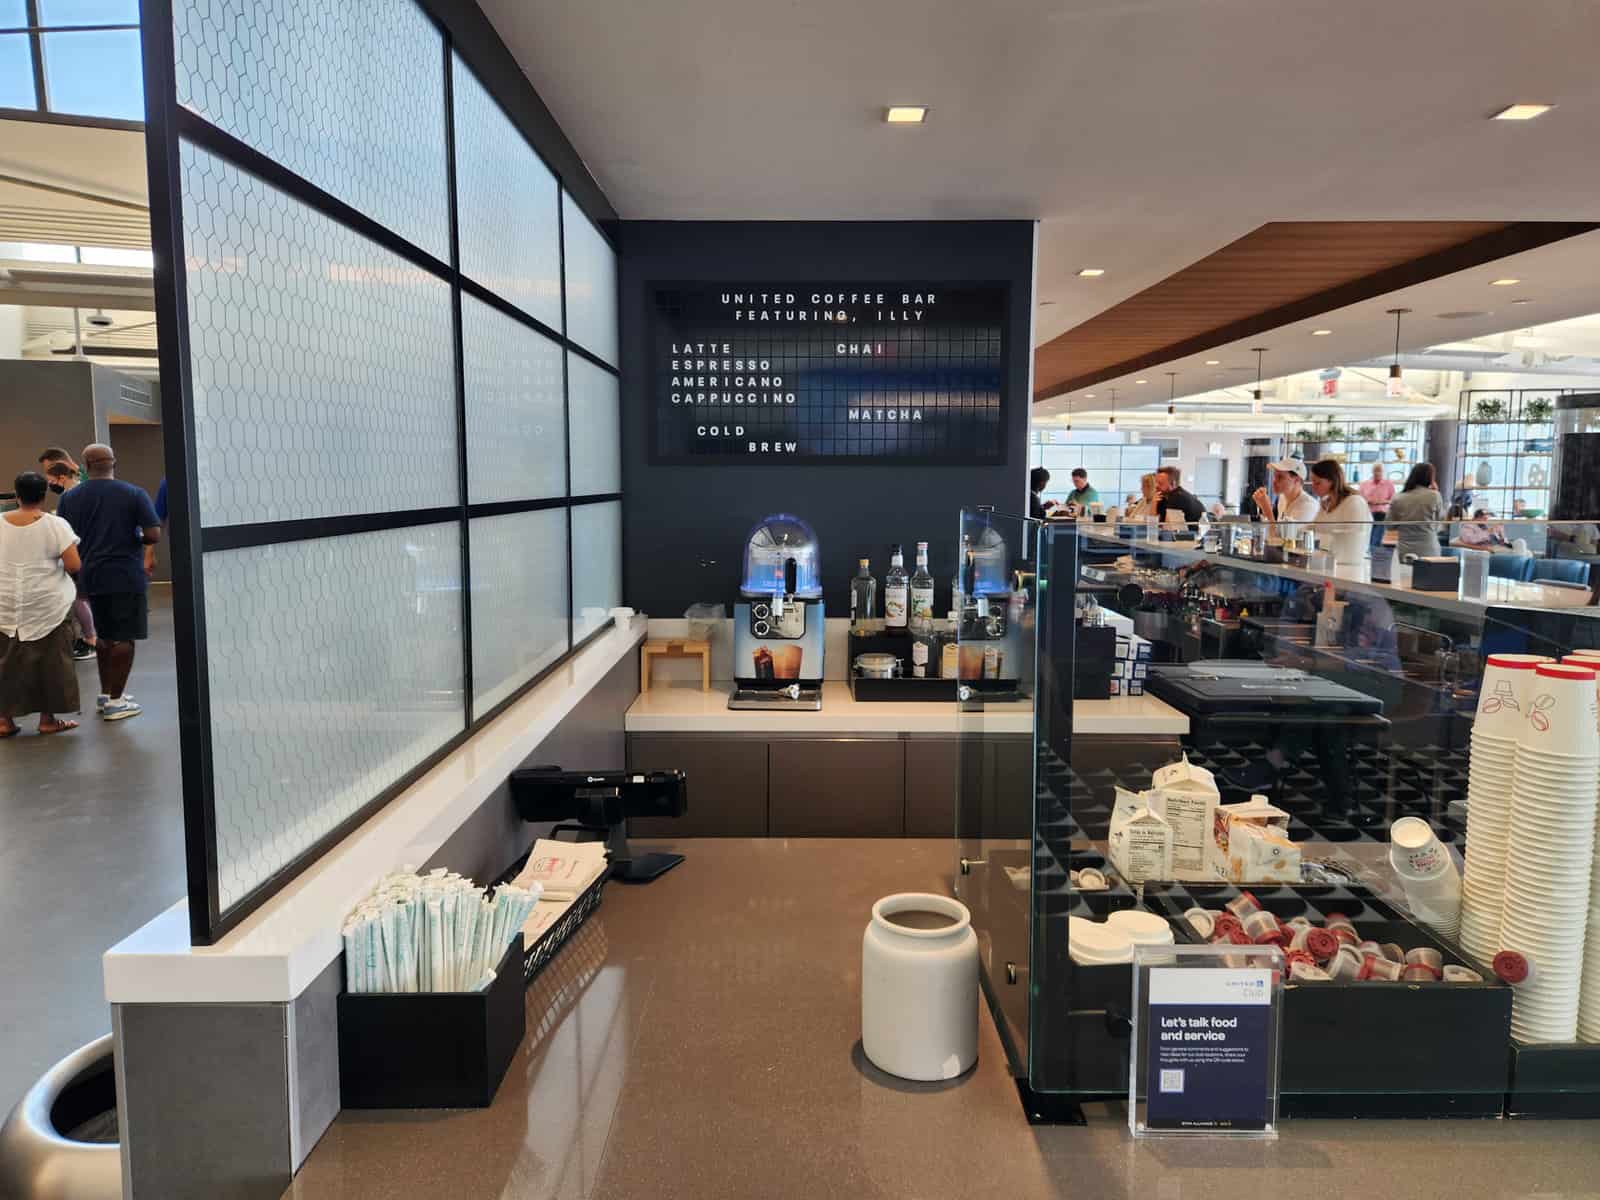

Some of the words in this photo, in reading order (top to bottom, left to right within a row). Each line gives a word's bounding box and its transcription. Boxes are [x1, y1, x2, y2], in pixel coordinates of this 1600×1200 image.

[721, 293, 795, 304] UNITED
[811, 293, 884, 304] COFFEE
[902, 293, 936, 304] BAR
[735, 310, 856, 322] FEATURING,
[878, 310, 924, 321] ILLY
[672, 343, 731, 354] LATTE
[836, 343, 882, 354] CHAI
[671, 360, 770, 371] ESPRESSO
[671, 376, 783, 387] AMERICANO
[671, 393, 796, 404] CAPPUCCINO
[848, 409, 922, 420] MATCHA
[697, 426, 745, 436] COLD
[748, 442, 797, 453] BREW
[1161, 1016, 1187, 1028] Let's
[1188, 1016, 1210, 1028] talk
[1211, 1016, 1238, 1028] food
[1160, 1030, 1183, 1041] and
[1184, 1030, 1226, 1041] service
